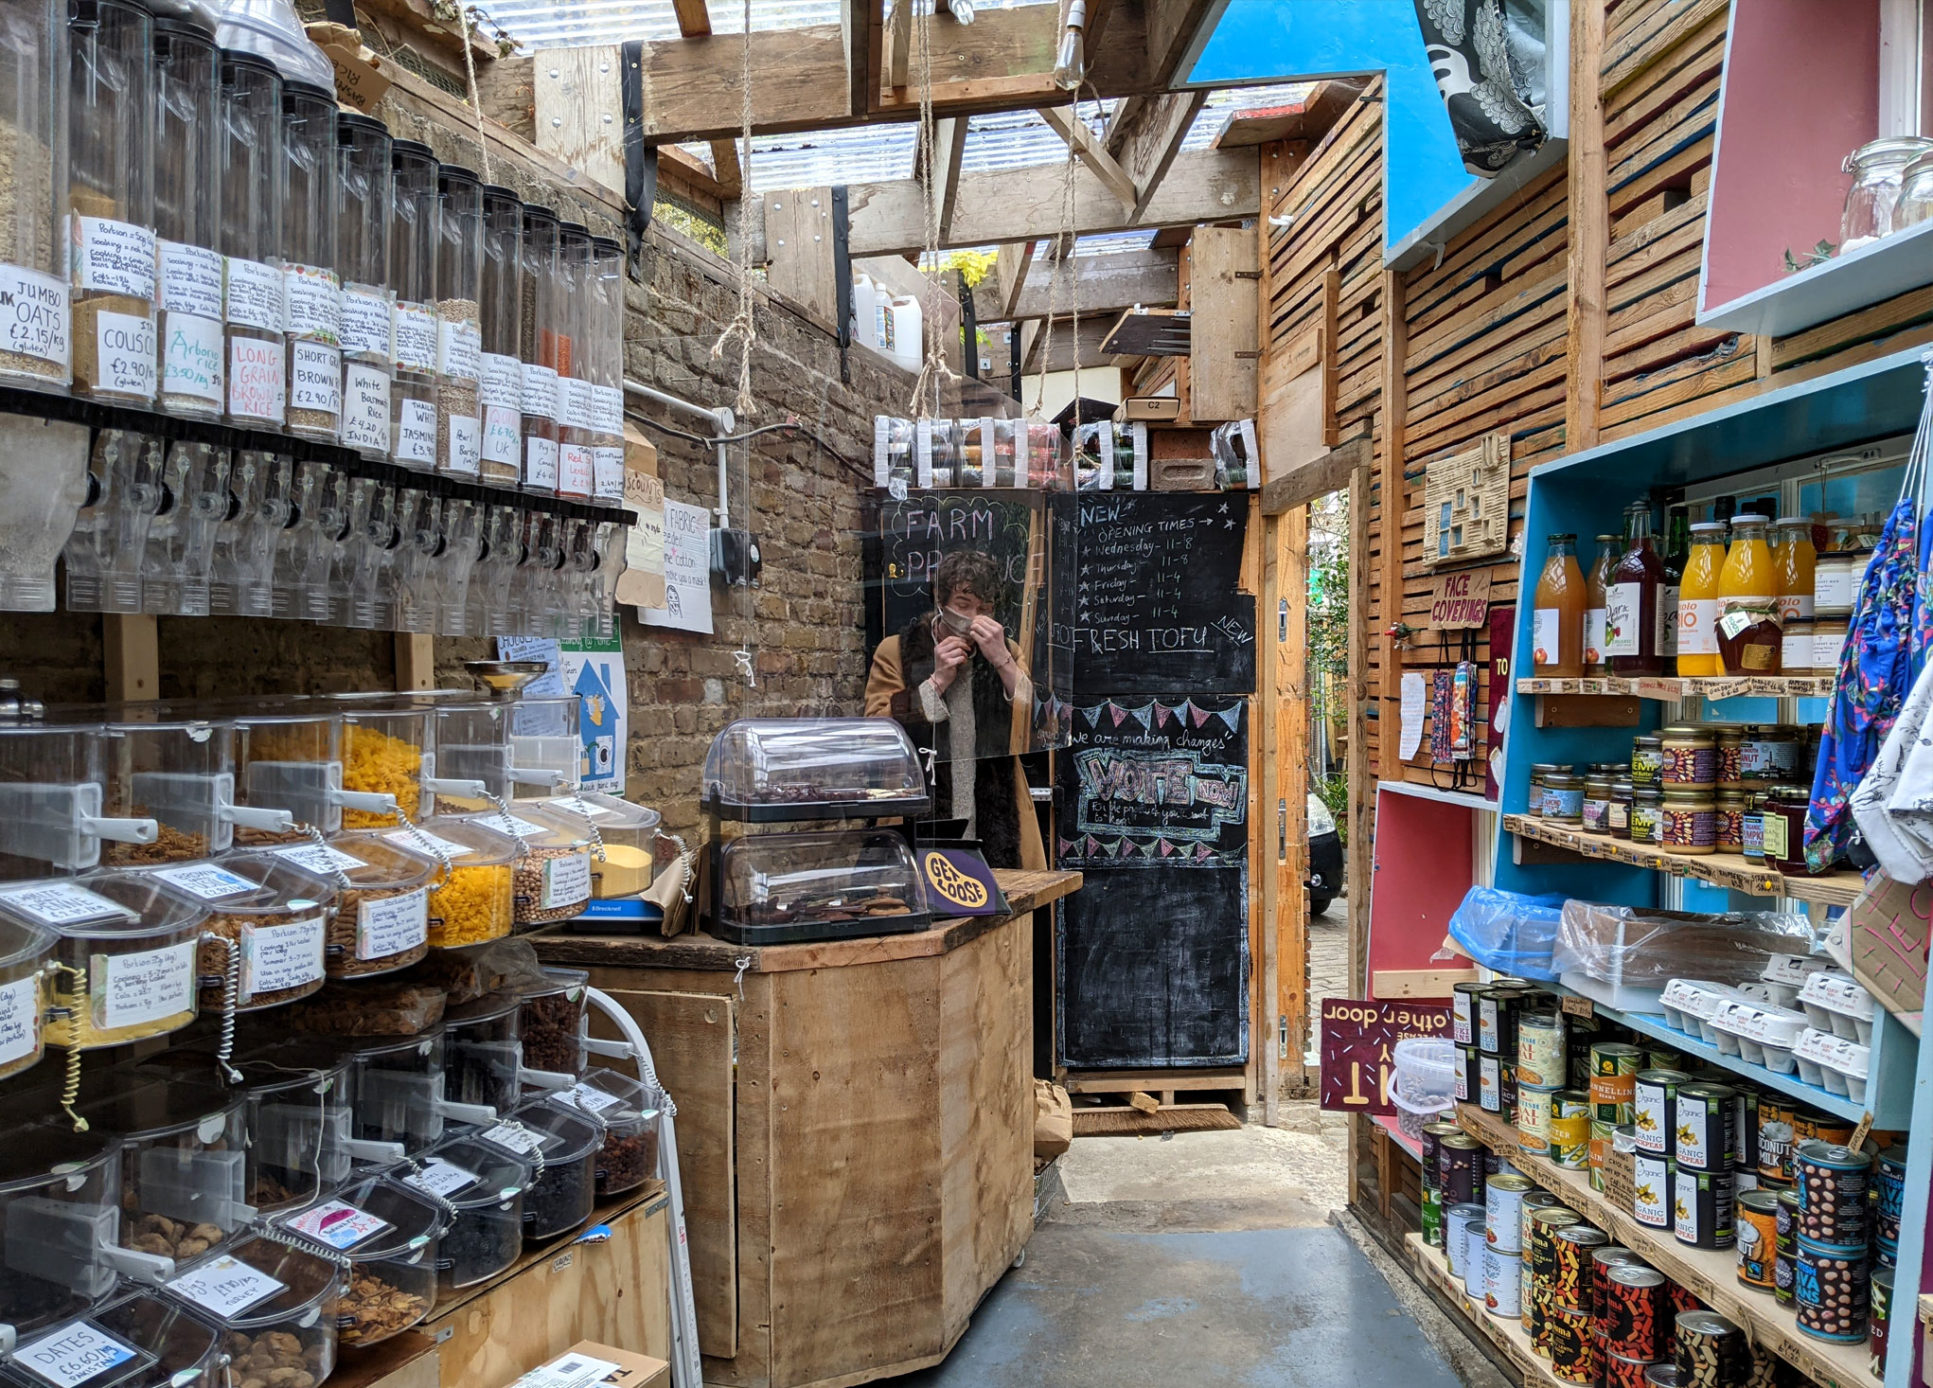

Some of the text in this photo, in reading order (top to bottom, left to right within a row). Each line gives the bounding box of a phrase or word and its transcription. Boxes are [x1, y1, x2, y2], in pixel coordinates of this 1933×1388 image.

[17, 281, 62, 309] JUMBO
[16, 302, 62, 331] OATS
[10, 328, 65, 353] £2.15/kg
[171, 330, 220, 363] Arborio
[197, 356, 218, 372] rice
[236, 345, 278, 367] LONG
[297, 347, 326, 366] SHORT
[240, 366, 279, 388] GRAIN
[297, 368, 334, 388] BROWN
[355, 376, 381, 393] White
[231, 385, 275, 402] BROWN
[244, 401, 273, 416] RICE
[367, 404, 383, 420] Rice
[1146, 401, 1161, 410] C2
[346, 430, 380, 448] INDIA
[403, 427, 436, 444] JASMINE
[494, 440, 510, 457] UK
[670, 507, 696, 534] FABRIC
[906, 508, 993, 542] FARM
[1080, 505, 1121, 528] NEW
[1097, 516, 1196, 544] OPENING TIMES
[1095, 536, 1193, 559] Wednesday 11-8
[675, 553, 697, 570] cotton
[907, 550, 1046, 586] PRCE
[1096, 551, 1189, 577] Thursday 11-8
[1093, 570, 1181, 595] Friday 11-4
[1444, 574, 1470, 598] FACE
[1093, 587, 1182, 607] Saturday 11-4
[1094, 604, 1178, 625] Sunday 11-4
[1431, 597, 1487, 624] COVERINGS
[1072, 615, 1254, 654] FRESH TOFU NEW
[1496, 658, 1508, 675] TO
[1071, 733, 1089, 745] we
[1094, 733, 1119, 744] are
[1123, 730, 1171, 748] making
[1088, 757, 1194, 806] VOTE
[1195, 778, 1239, 809] NOW
[930, 857, 961, 882] GET
[936, 878, 983, 903] LOOSE
[1324, 1005, 1447, 1033] other door
[177, 1279, 207, 1300] figs
[225, 1287, 259, 1307] TURKEY
[34, 1331, 95, 1365] DATES
[69, 1356, 116, 1382] PAKISTAN
